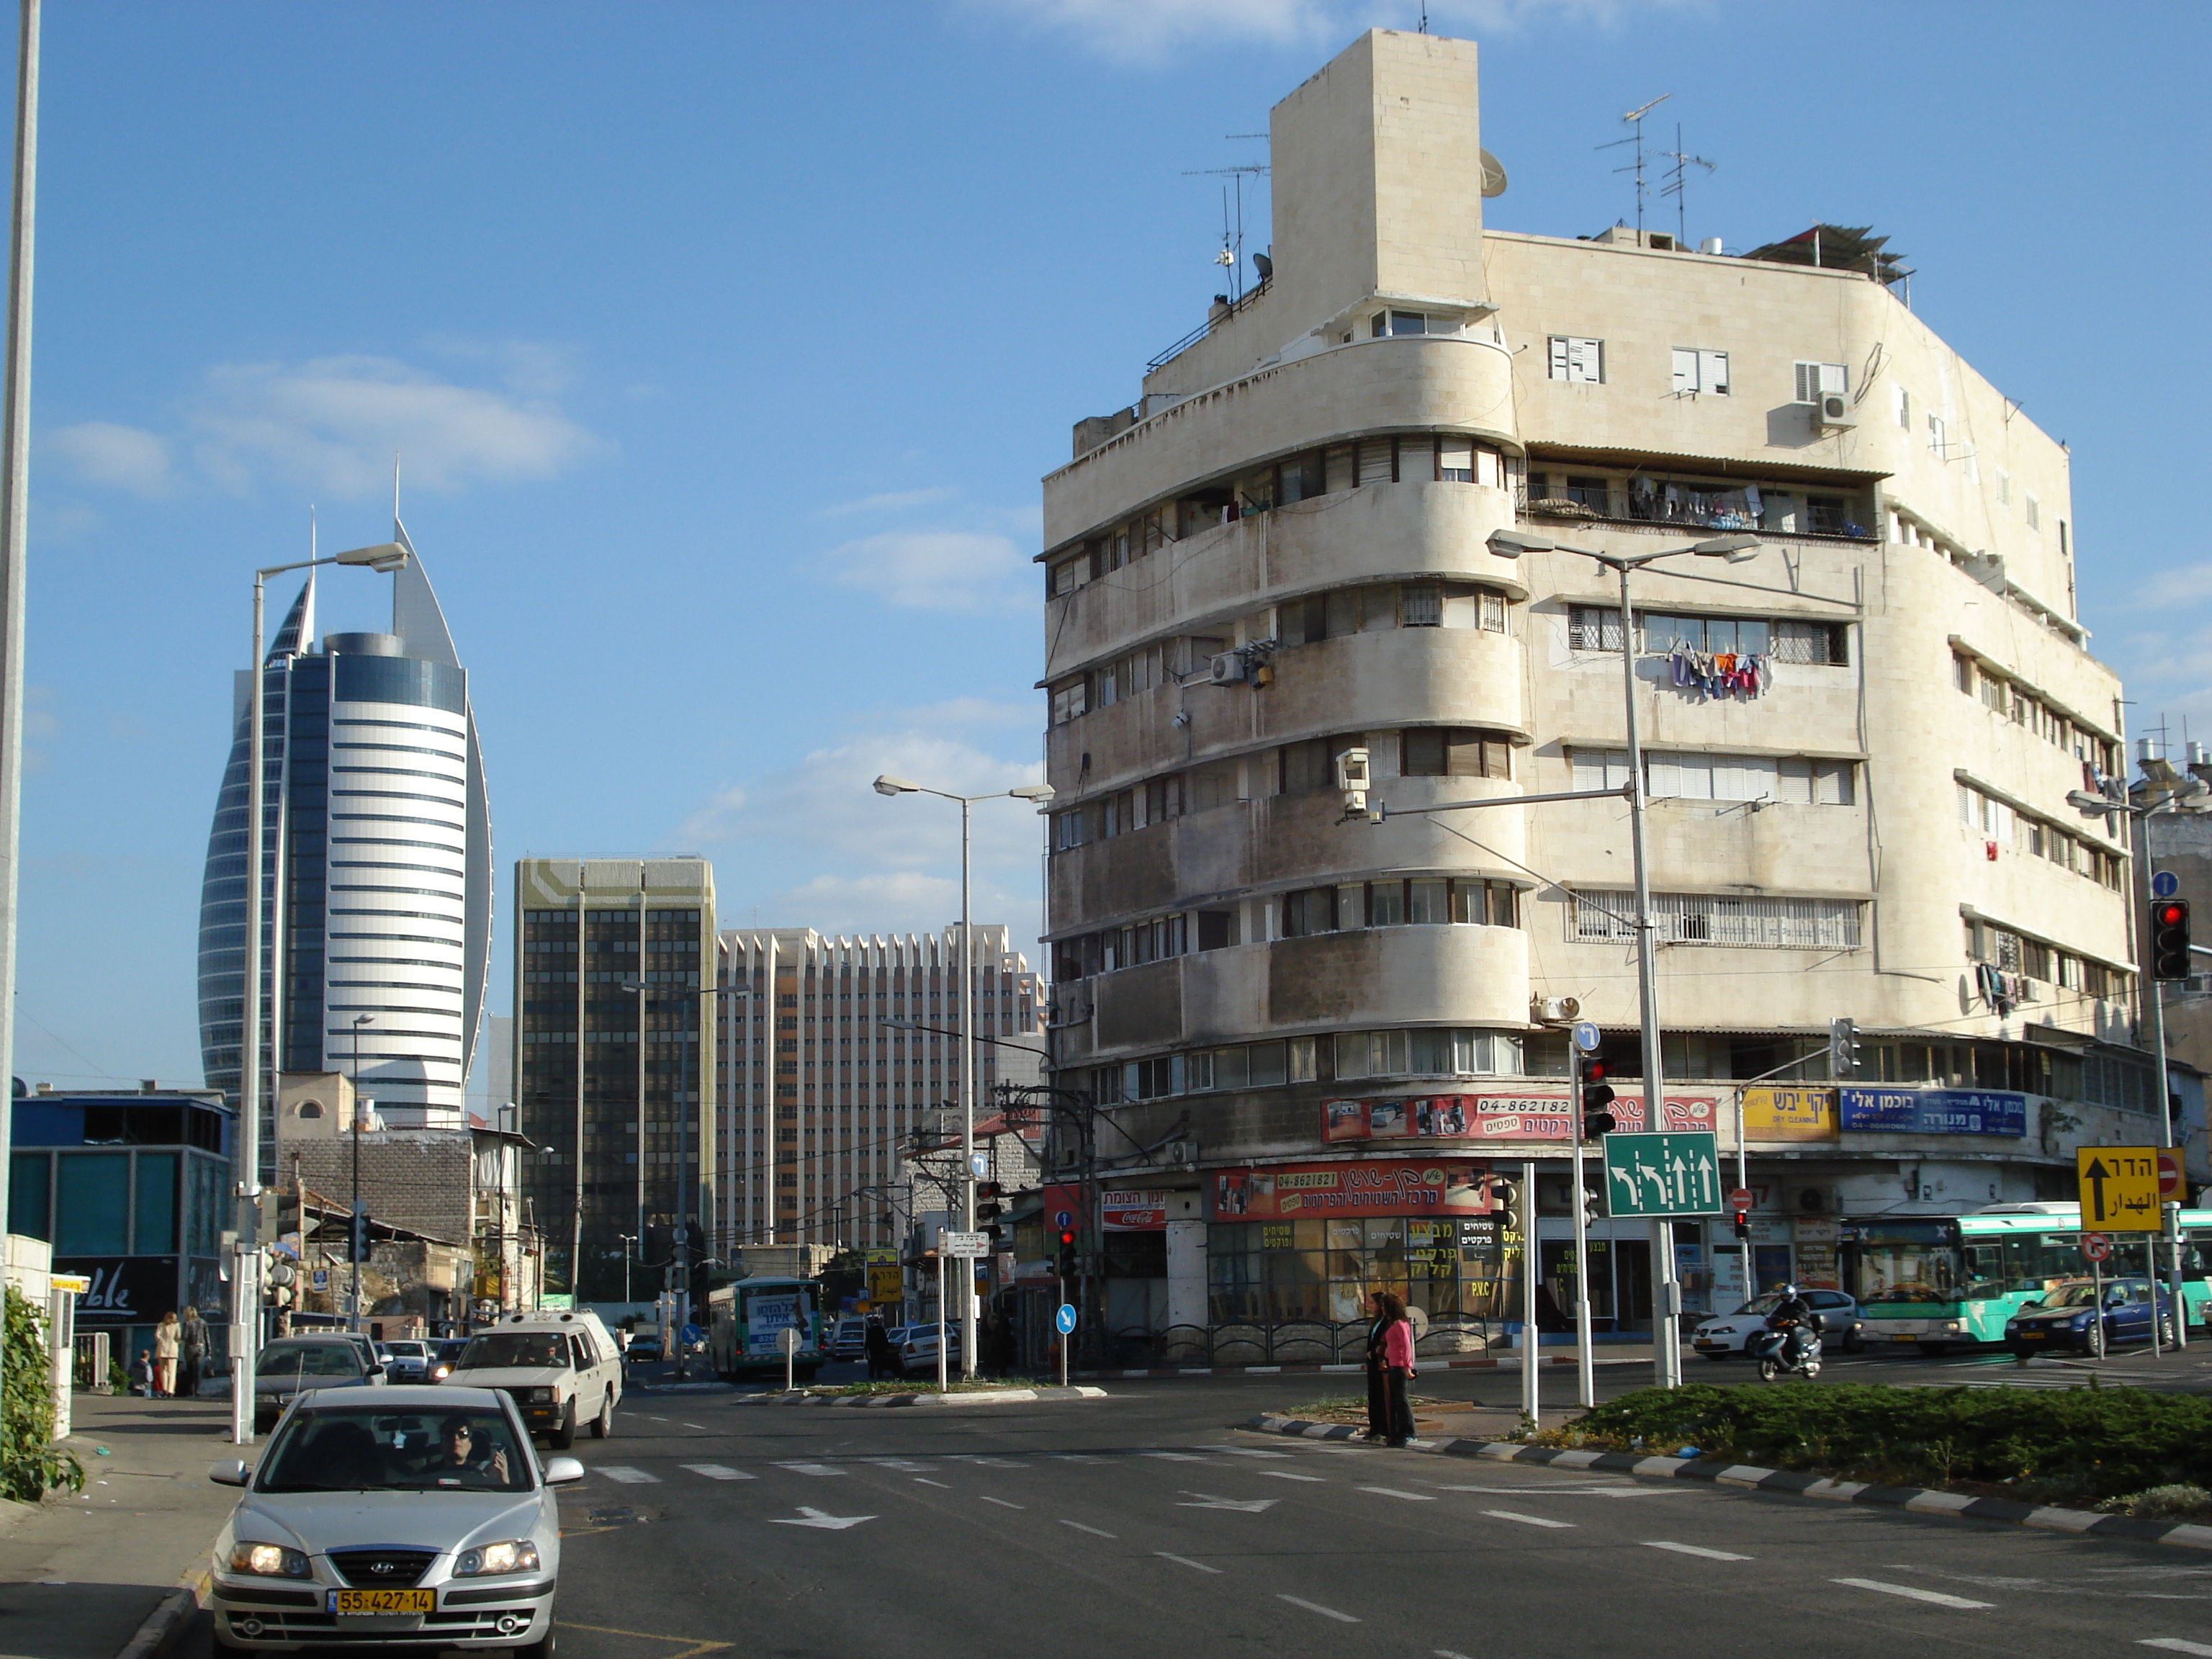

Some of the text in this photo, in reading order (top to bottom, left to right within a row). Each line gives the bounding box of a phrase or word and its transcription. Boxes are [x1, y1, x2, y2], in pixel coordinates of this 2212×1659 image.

[1480, 1100, 1570, 1112] 04-862182
[1773, 1092, 1800, 1111] יבש
[1851, 1091, 1874, 1107] אלי
[1879, 1095, 1915, 1112] בוכמן
[1983, 1094, 2000, 1112] אלי
[1486, 1118, 1517, 1132] טפטים
[1923, 1112, 1966, 1125] מנורה
[2108, 1158, 2152, 1177] הדר
[1278, 1174, 1335, 1187] 04-8621821
[1104, 1192, 1141, 1204] הצומת
[1352, 1190, 1400, 1207] השטיחים
[1407, 1190, 1438, 1205] מרכז
[2109, 1192, 2157, 1217] الهدار
[1263, 1226, 1290, 1236] שטיחים
[1333, 1228, 1359, 1236] פרקטים
[1411, 1223, 1453, 1239] מבצע
[1464, 1222, 1494, 1231] שטיחים
[1370, 1231, 1401, 1240] שטיחים
[1461, 1236, 1492, 1246] פרקטים
[1588, 1242, 1606, 1252] מבצע
[1411, 1261, 1452, 1277] קליק
